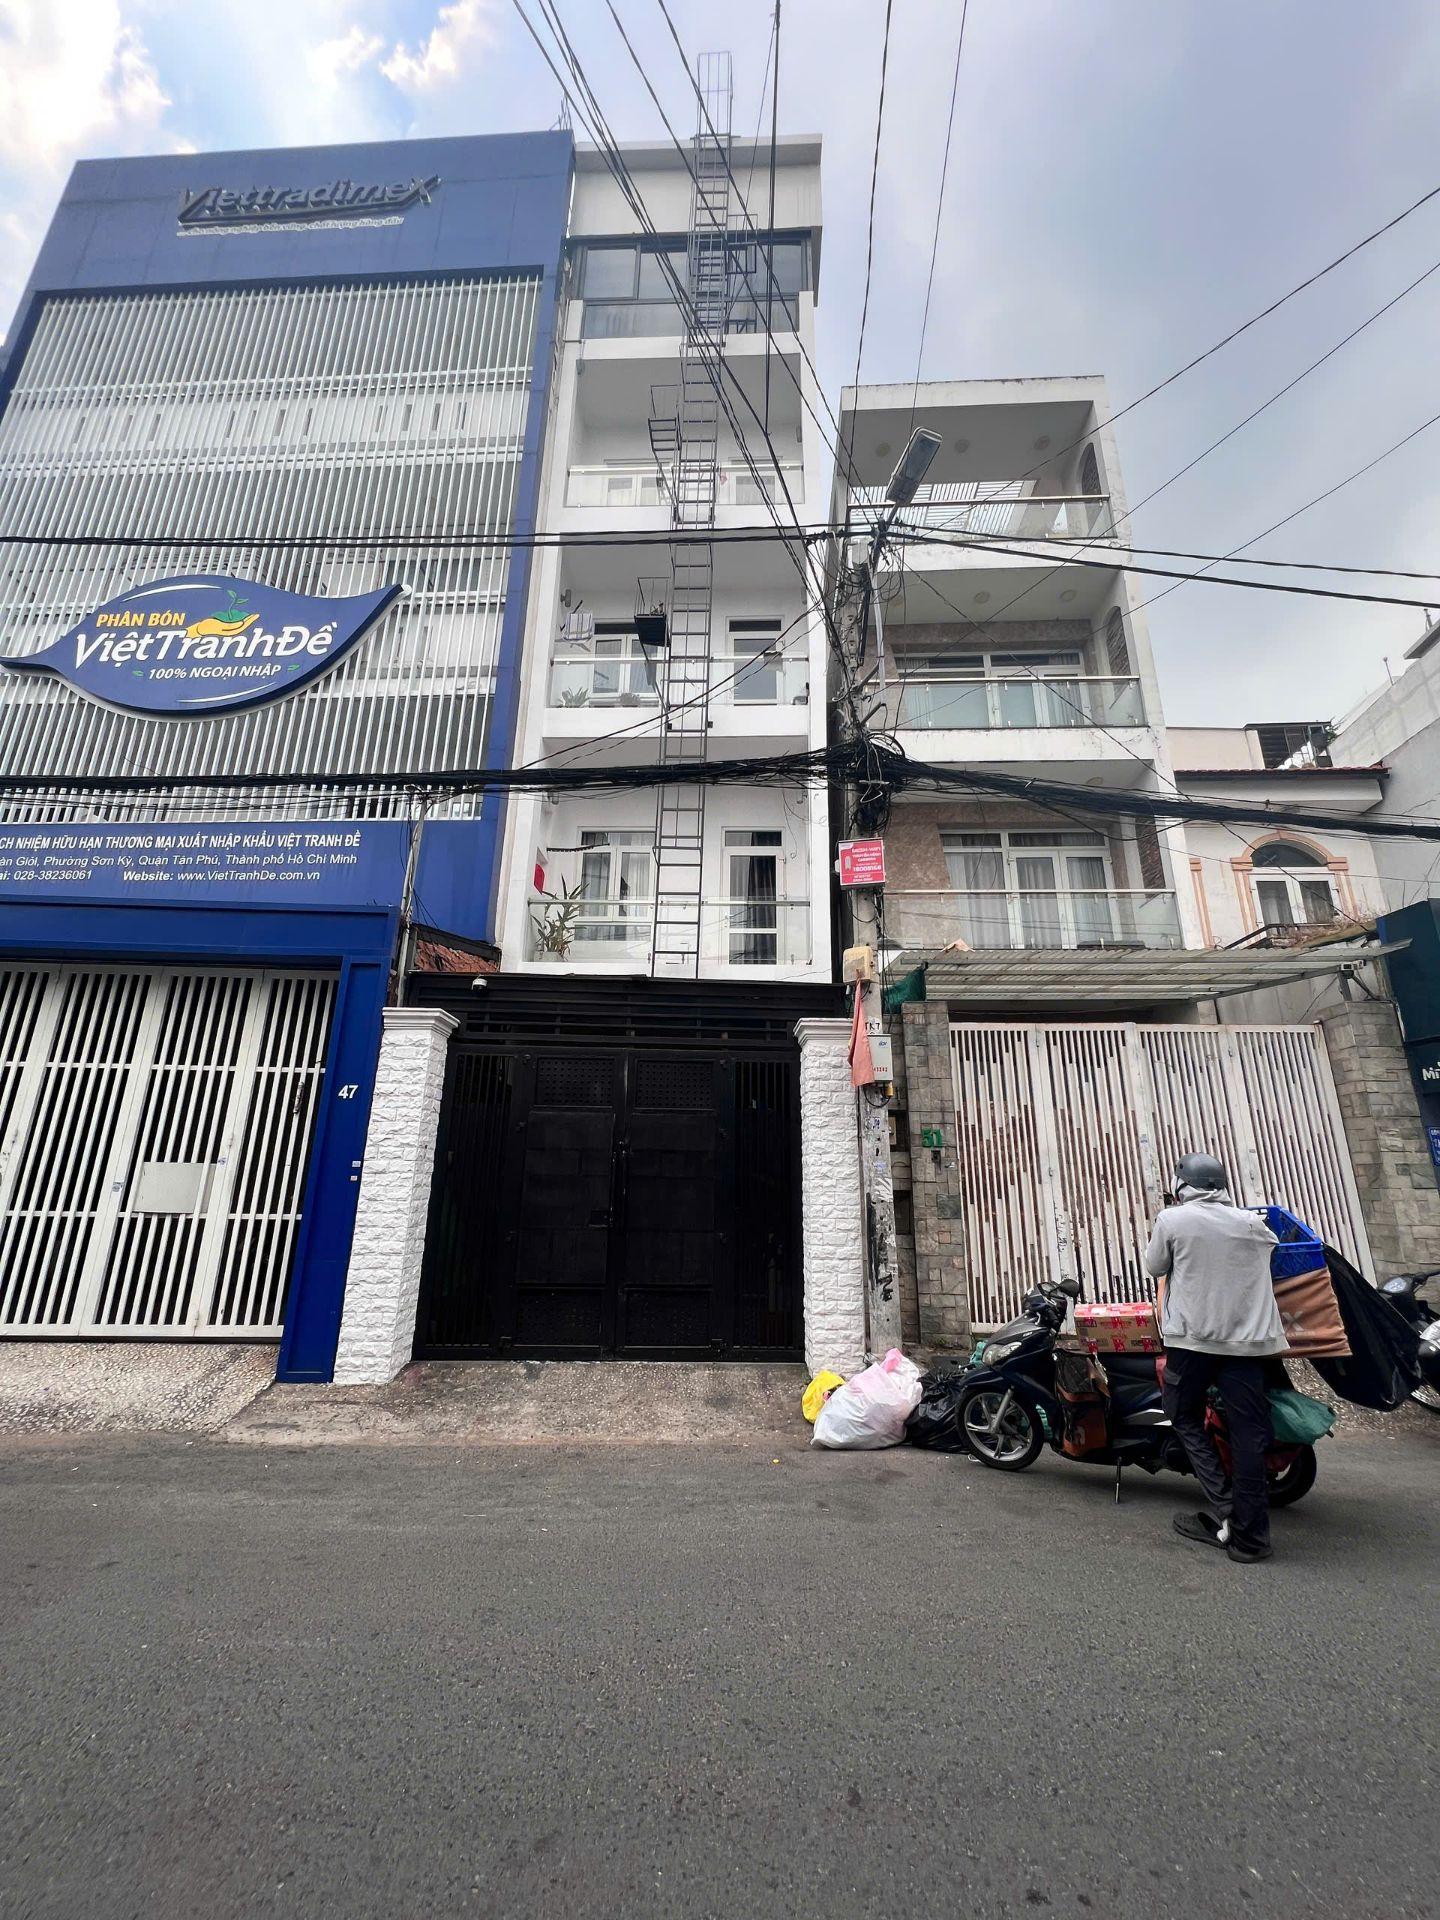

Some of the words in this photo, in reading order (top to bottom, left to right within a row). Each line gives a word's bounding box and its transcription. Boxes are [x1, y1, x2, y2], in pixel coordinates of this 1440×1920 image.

[96, 610, 145, 627] PHÂN
[147, 609, 186, 626] BÓN
[149, 667, 187, 680] 100%
[189, 665, 237, 680] NGOẠI
[238, 663, 282, 677] NHẬP
[15, 834, 51, 851] NHIỆM
[52, 835, 77, 849] HỮU
[79, 836, 103, 851] HẠN
[106, 836, 153, 849] THƯƠNG
[155, 836, 174, 851] MẠI
[178, 831, 208, 849] XUẤT
[209, 833, 241, 850] NHẬP
[243, 830, 275, 848] KHẨU
[277, 832, 302, 850] VIỆT
[304, 834, 342, 847] TRANH
[345, 830, 362, 847] ĐỀ
[91, 855, 115, 866] Sơn
[138, 855, 168, 868] Quận
[172, 855, 193, 865] Tân
[196, 854, 221, 866] Phú,
[225, 854, 262, 865] Thành
[262, 853, 284, 866] phố
[306, 853, 327, 864] Chí
[329, 853, 357, 864] Minh
[13, 870, 92, 880] 028-38236061
[123, 870, 174, 881] Website:
[177, 869, 320, 881] www.VietTranhDe.com.vn
[338, 1085, 359, 1099] 47
[922, 1128, 942, 1148] 51
